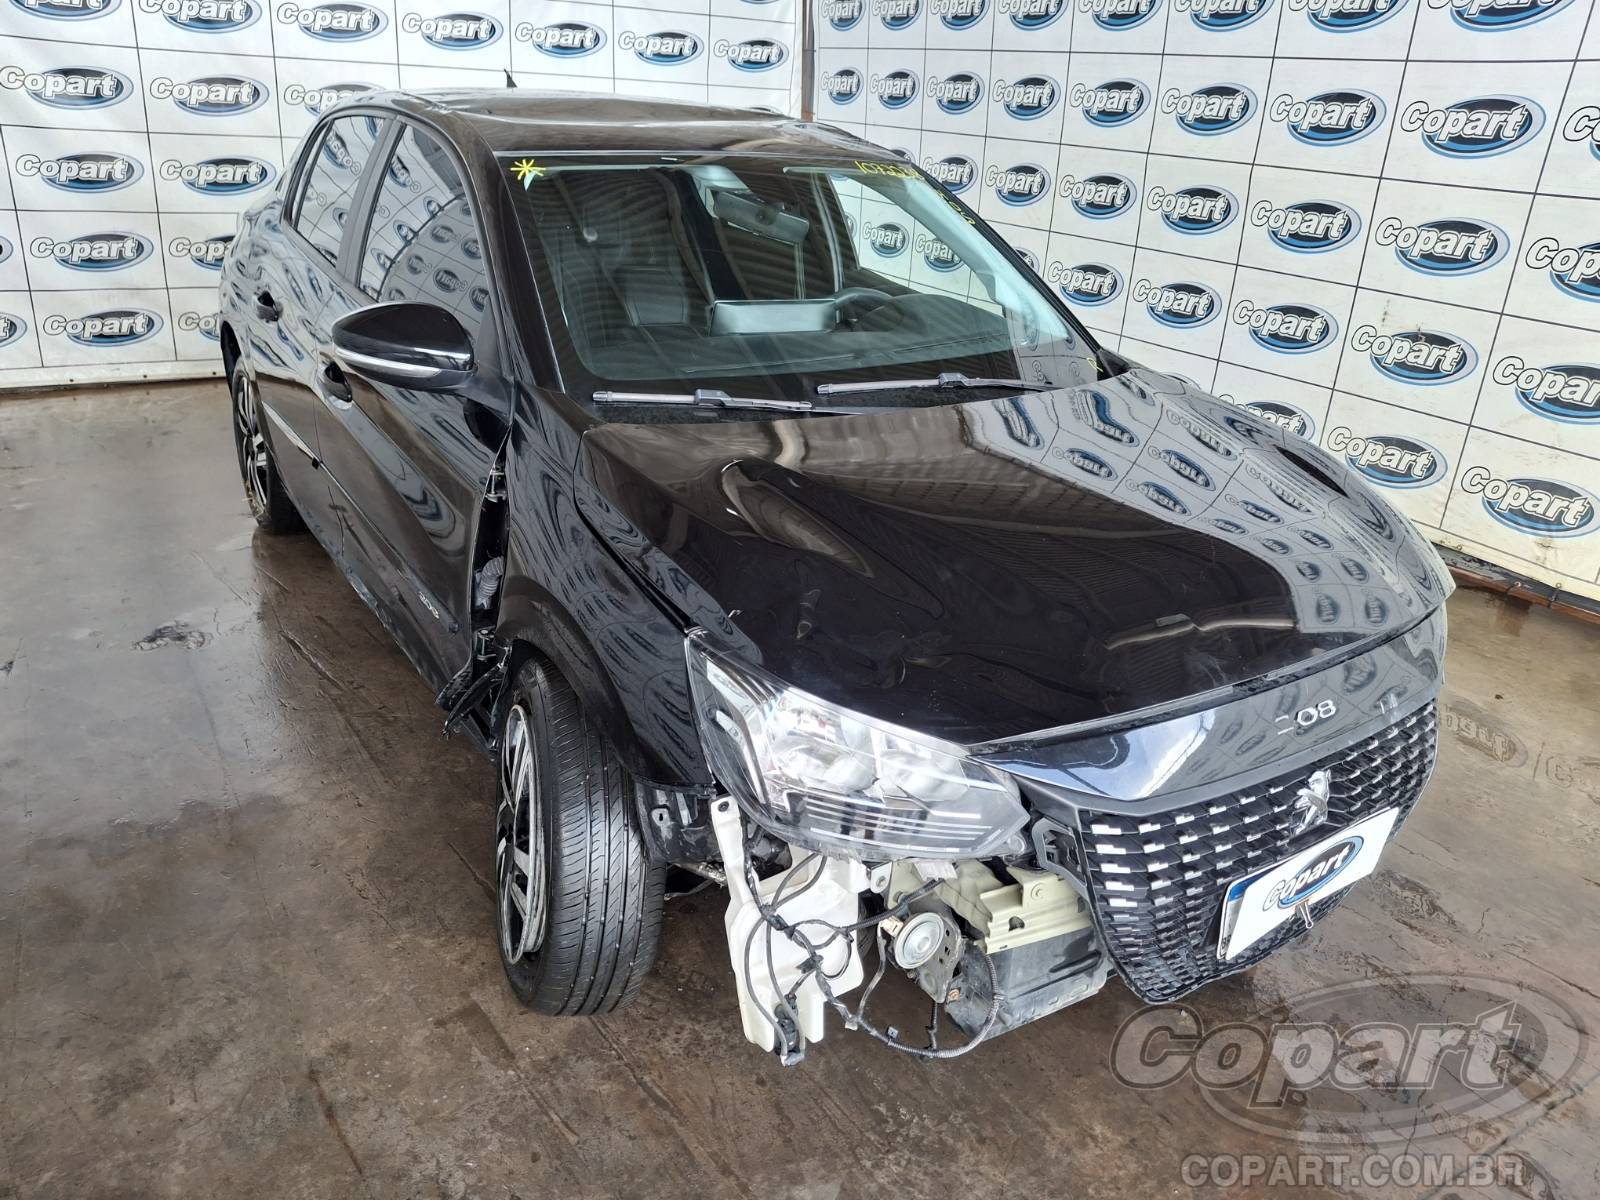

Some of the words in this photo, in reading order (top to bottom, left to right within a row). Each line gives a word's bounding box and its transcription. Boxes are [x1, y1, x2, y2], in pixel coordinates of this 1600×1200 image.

[277, 3, 375, 33] Copart
[822, 0, 860, 24] Copart
[872, 0, 915, 23] Copart
[402, 13, 492, 41] Copart
[515, 22, 596, 48] Copart
[618, 31, 698, 56] Copart
[713, 39, 781, 63] Copart
[0, 66, 118, 99] Copart
[150, 77, 256, 106] Copart
[821, 71, 860, 95] Copart
[870, 72, 914, 100] Copart
[927, 75, 978, 103] Copart
[992, 80, 1054, 109] Copart
[1070, 84, 1144, 114] Copart
[1161, 88, 1247, 122] Copart
[1269, 94, 1373, 133] Copart
[1401, 101, 1528, 143] Copart
[16, 154, 128, 182] Copart
[160, 159, 263, 186] Copart
[922, 156, 974, 184] Copart
[985, 165, 1044, 195] Copart
[1059, 175, 1129, 208] Copart
[1147, 186, 1228, 221] Copart
[1251, 199, 1350, 240] Copart
[30, 236, 140, 263] Copart
[863, 222, 903, 249] Copart
[1375, 217, 1494, 261] Copart
[1048, 260, 1115, 295] Copart
[1133, 279, 1211, 318] Copart
[43, 312, 151, 338] Copart
[1233, 300, 1328, 343] Copart
[1351, 324, 1465, 372] Copart
[1327, 427, 1434, 479] Copart
[1461, 466, 1588, 528] Copart
[1263, 838, 1351, 912] Copart
